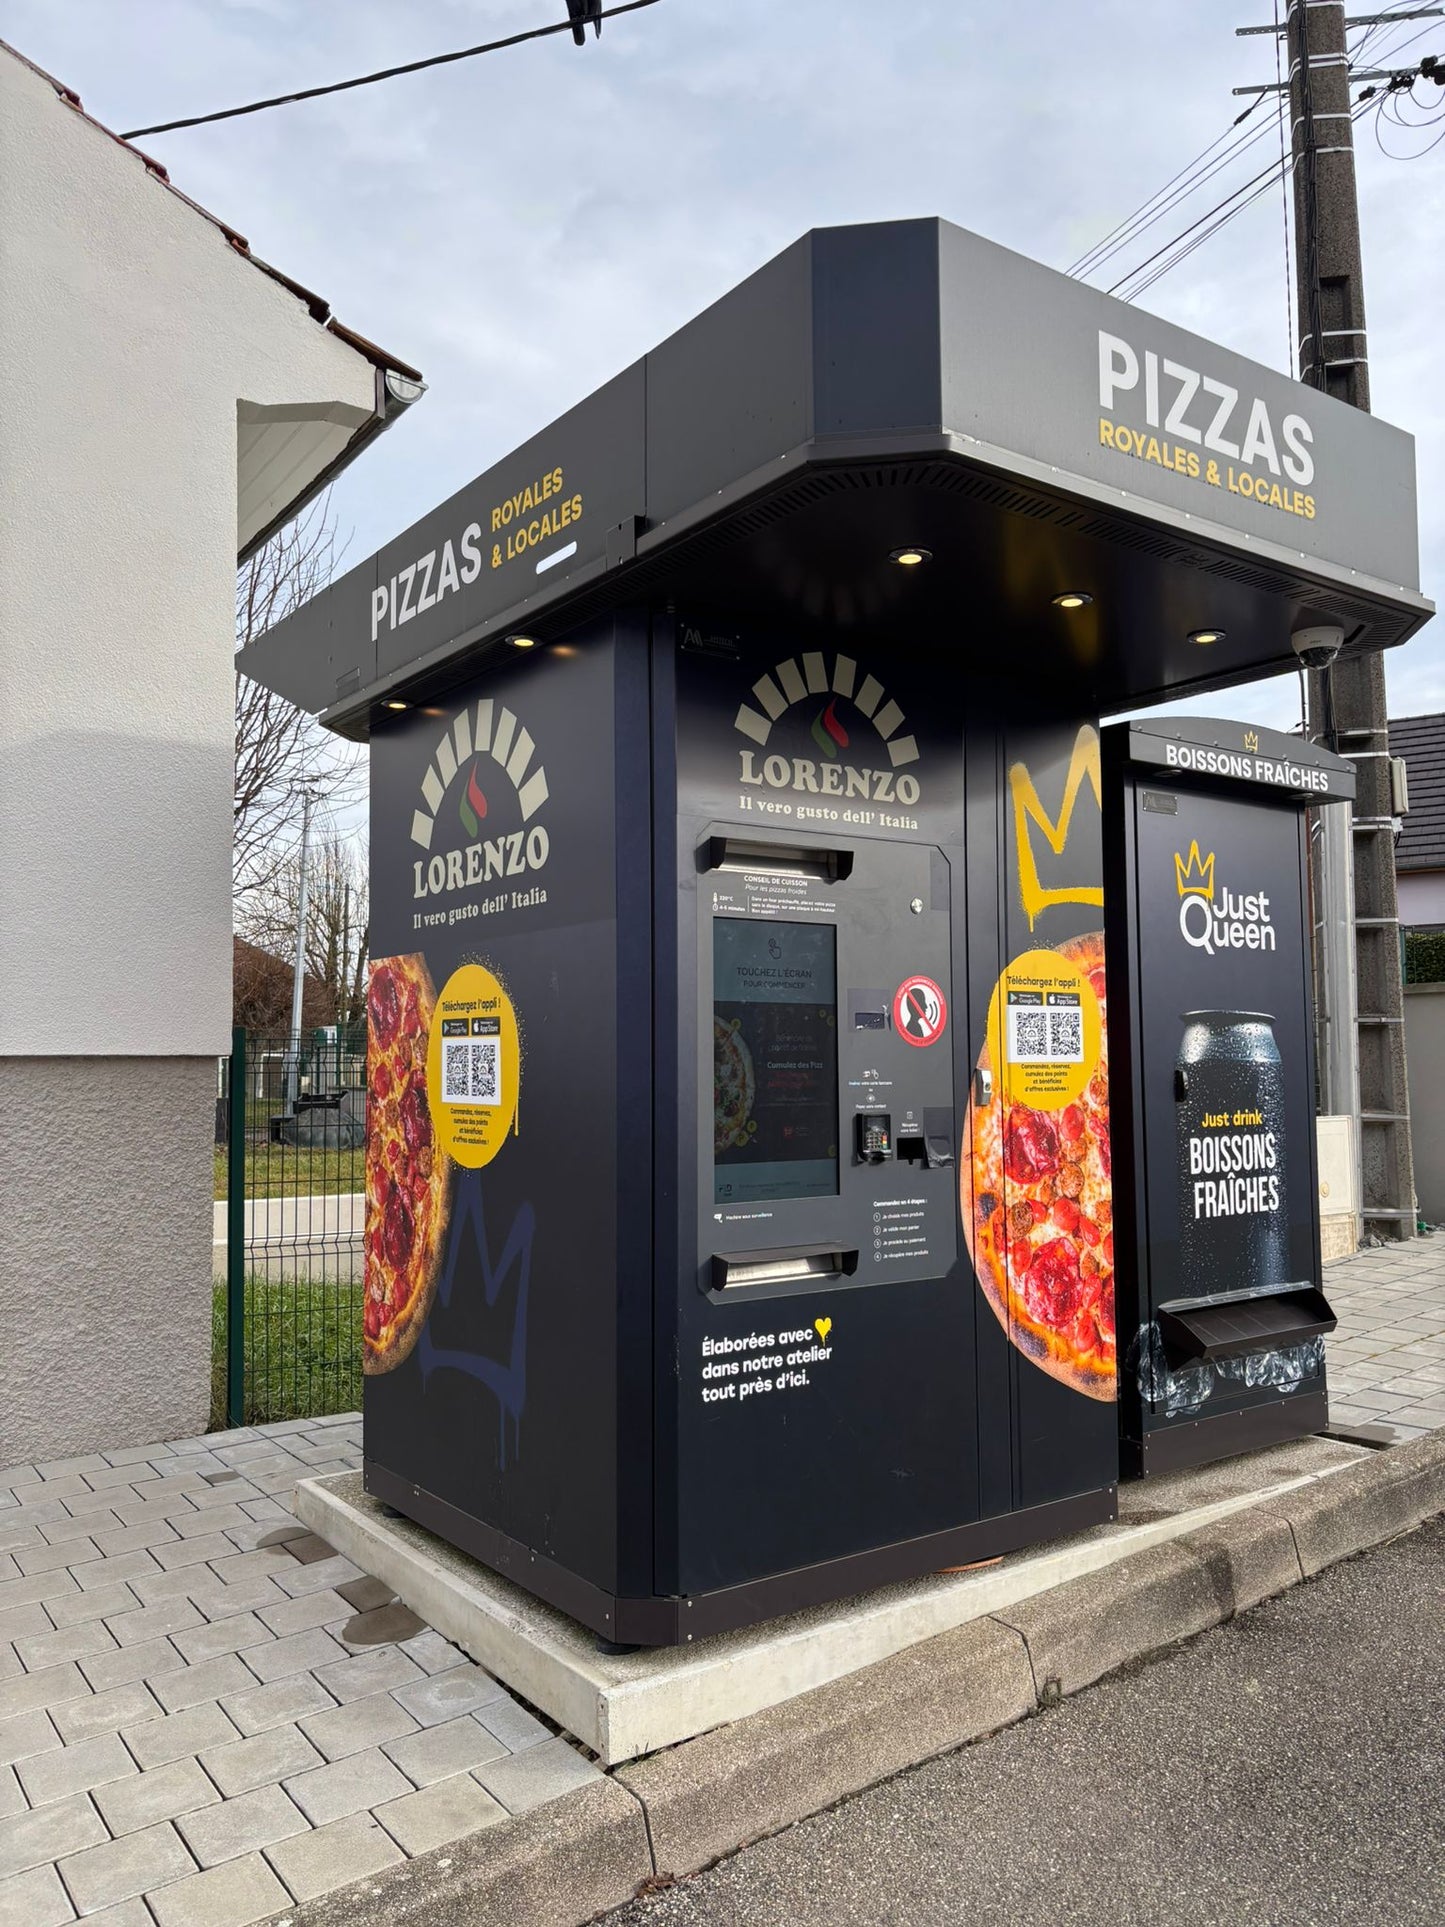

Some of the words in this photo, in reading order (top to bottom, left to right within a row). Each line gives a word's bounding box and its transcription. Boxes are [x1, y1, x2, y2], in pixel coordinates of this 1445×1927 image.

[1099, 330, 1314, 486] PIZZAS
[1100, 418, 1200, 477] ROYALES
[1206, 460, 1221, 487] &
[1228, 467, 1316, 519] LOCALES
[491, 467, 563, 532] ROYALES
[492, 544, 502, 569] &
[507, 494, 583, 560] LOCALES
[372, 522, 482, 642] PIZZAS
[739, 750, 921, 805] LORENZO
[1166, 744, 1251, 778] BOISSONS
[1255, 761, 1329, 791] FRAÎCHES
[739, 795, 752, 810] Il
[757, 800, 792, 814] vero
[796, 806, 838, 821] gusto
[879, 813, 918, 830] Italia
[413, 825, 550, 899] LORENZO
[744, 875, 770, 884] CONSEIL
[781, 878, 808, 887] CUISSON
[413, 913, 422, 929] Il
[424, 913, 446, 926] vero
[449, 904, 478, 926] gusto
[511, 887, 548, 909] Italia
[768, 887, 787, 895] pizzas
[1213, 886, 1270, 922] Just
[1179, 895, 1276, 955] Queen
[736, 966, 777, 977] TOUCHEZ
[1006, 976, 1052, 988] Téléchargez
[442, 1000, 477, 1014] Téléchargez
[767, 1061, 797, 1069] Cumulez
[1202, 1112, 1230, 1128] Just
[1233, 1109, 1263, 1126] drink
[1189, 1132, 1277, 1175] BOISSONS
[1194, 1171, 1280, 1220] FRAÎCHES
[702, 1332, 775, 1357] Élaborées
[778, 1328, 813, 1345] avec
[702, 1362, 740, 1379] dans
[742, 1354, 783, 1372] notre
[786, 1345, 832, 1365] atelier
[701, 1383, 736, 1402] tout
[739, 1376, 773, 1400] près
[776, 1369, 810, 1389] d'ici.
